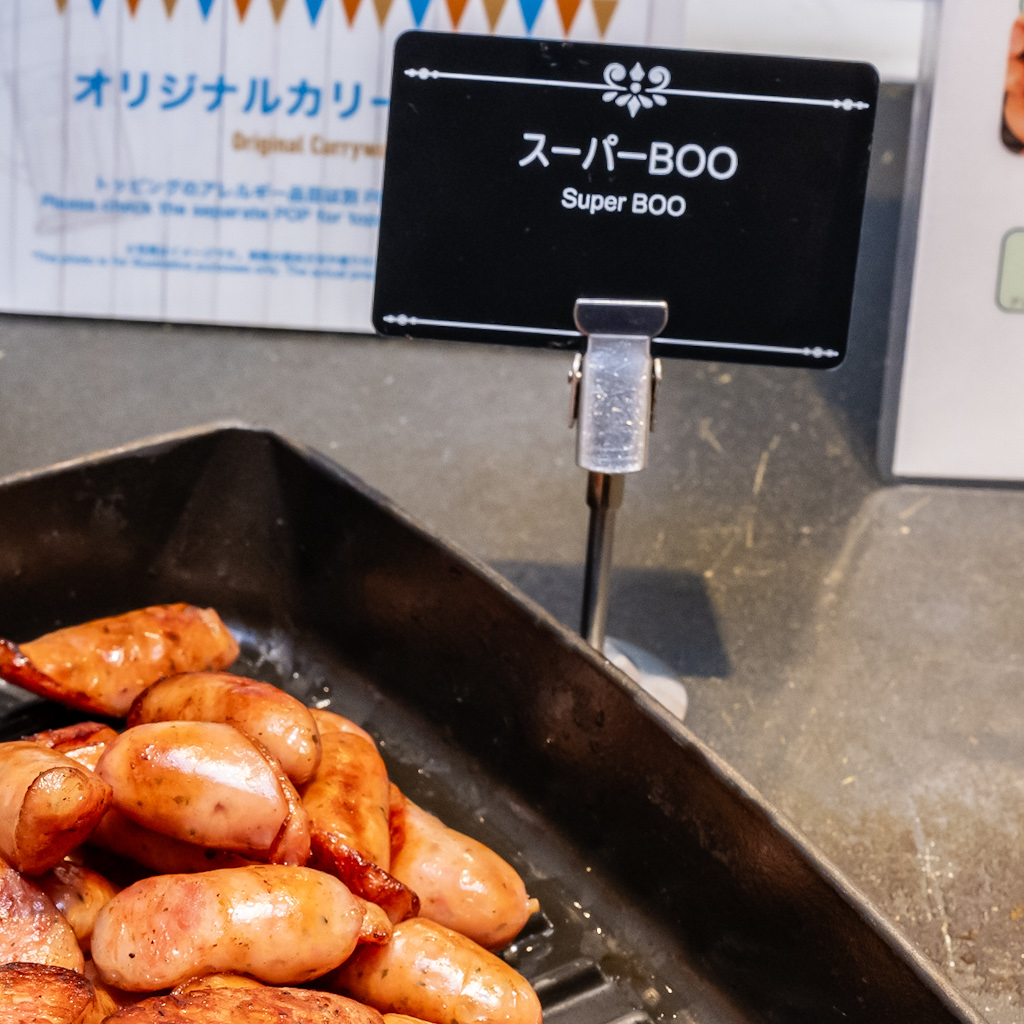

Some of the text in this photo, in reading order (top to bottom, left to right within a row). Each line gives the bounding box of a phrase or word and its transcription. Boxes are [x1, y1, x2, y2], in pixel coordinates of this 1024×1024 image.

[232, 131, 304, 158] Original
[519, 132, 739, 181] スーパーBOO
[40, 194, 96, 212] Please
[101, 198, 151, 215] check
[159, 201, 186, 216] the
[561, 187, 687, 217] Super BOO
